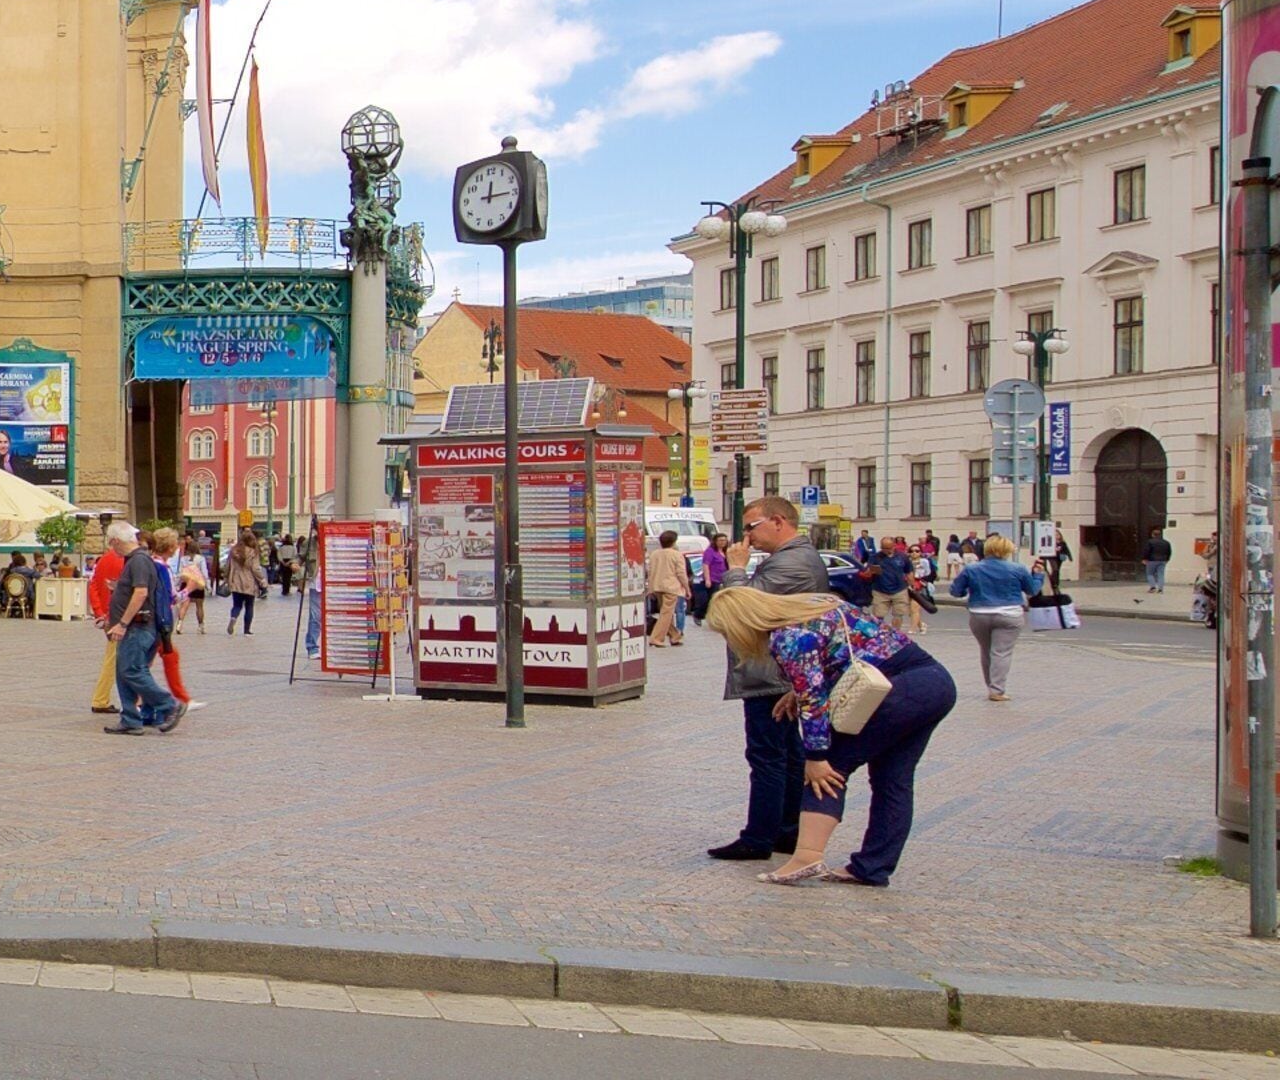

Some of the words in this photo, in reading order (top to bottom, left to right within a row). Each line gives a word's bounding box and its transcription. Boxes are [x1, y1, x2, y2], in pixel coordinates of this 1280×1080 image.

[486, 166, 496, 176] 12
[475, 174, 483, 183] 11
[508, 175, 514, 184] 2
[467, 184, 478, 194] 10
[511, 187, 518, 196] 3
[463, 198, 470, 207] 9
[476, 217, 481, 226] 7
[499, 213, 505, 222] 5
[487, 218, 493, 227] 6
[249, 328, 286, 341] JARO
[176, 341, 235, 354] PRAGUE
[237, 340, 289, 353] SPRING
[0, 372, 34, 380] CARMINA
[433, 445, 507, 461] WALKING
[804, 488, 816, 500] P
[423, 645, 495, 659] MARTIN
[523, 649, 572, 663] TOUR
